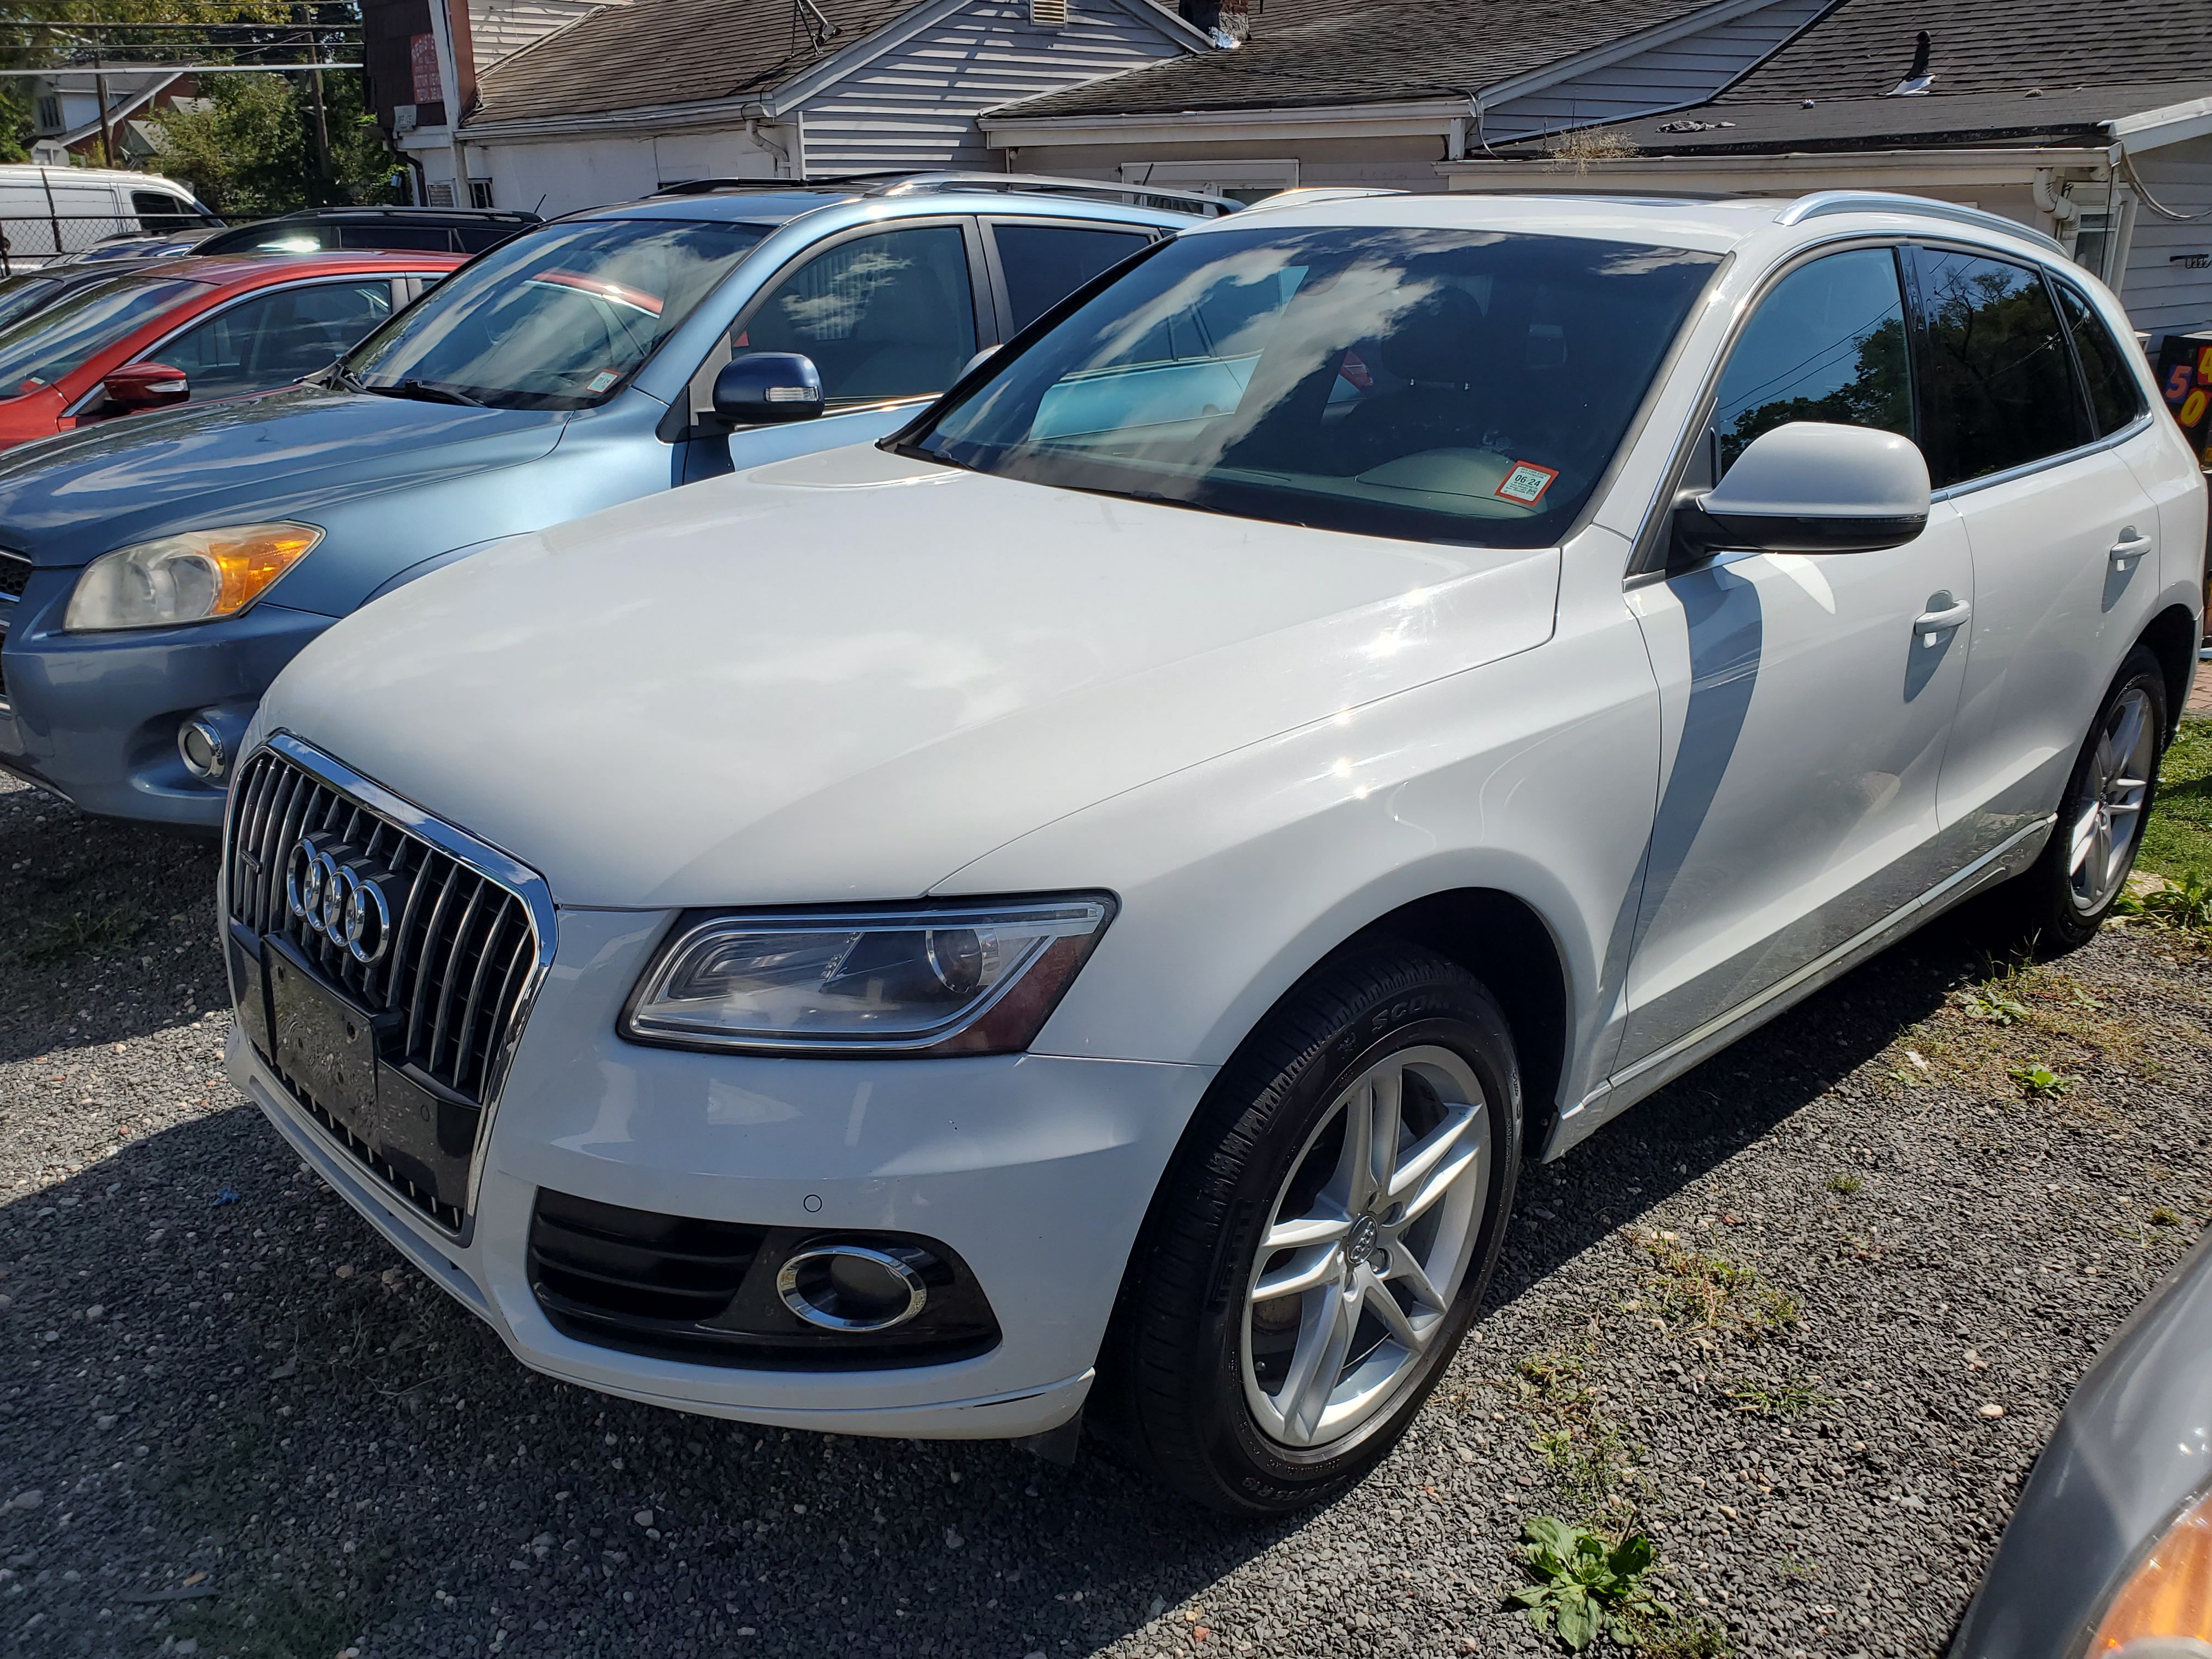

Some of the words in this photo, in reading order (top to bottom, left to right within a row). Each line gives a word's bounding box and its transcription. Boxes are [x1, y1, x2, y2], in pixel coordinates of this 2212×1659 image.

[2166, 365, 2192, 398] 5
[1515, 475, 1528, 483] 06
[1527, 478, 1541, 487] 24
